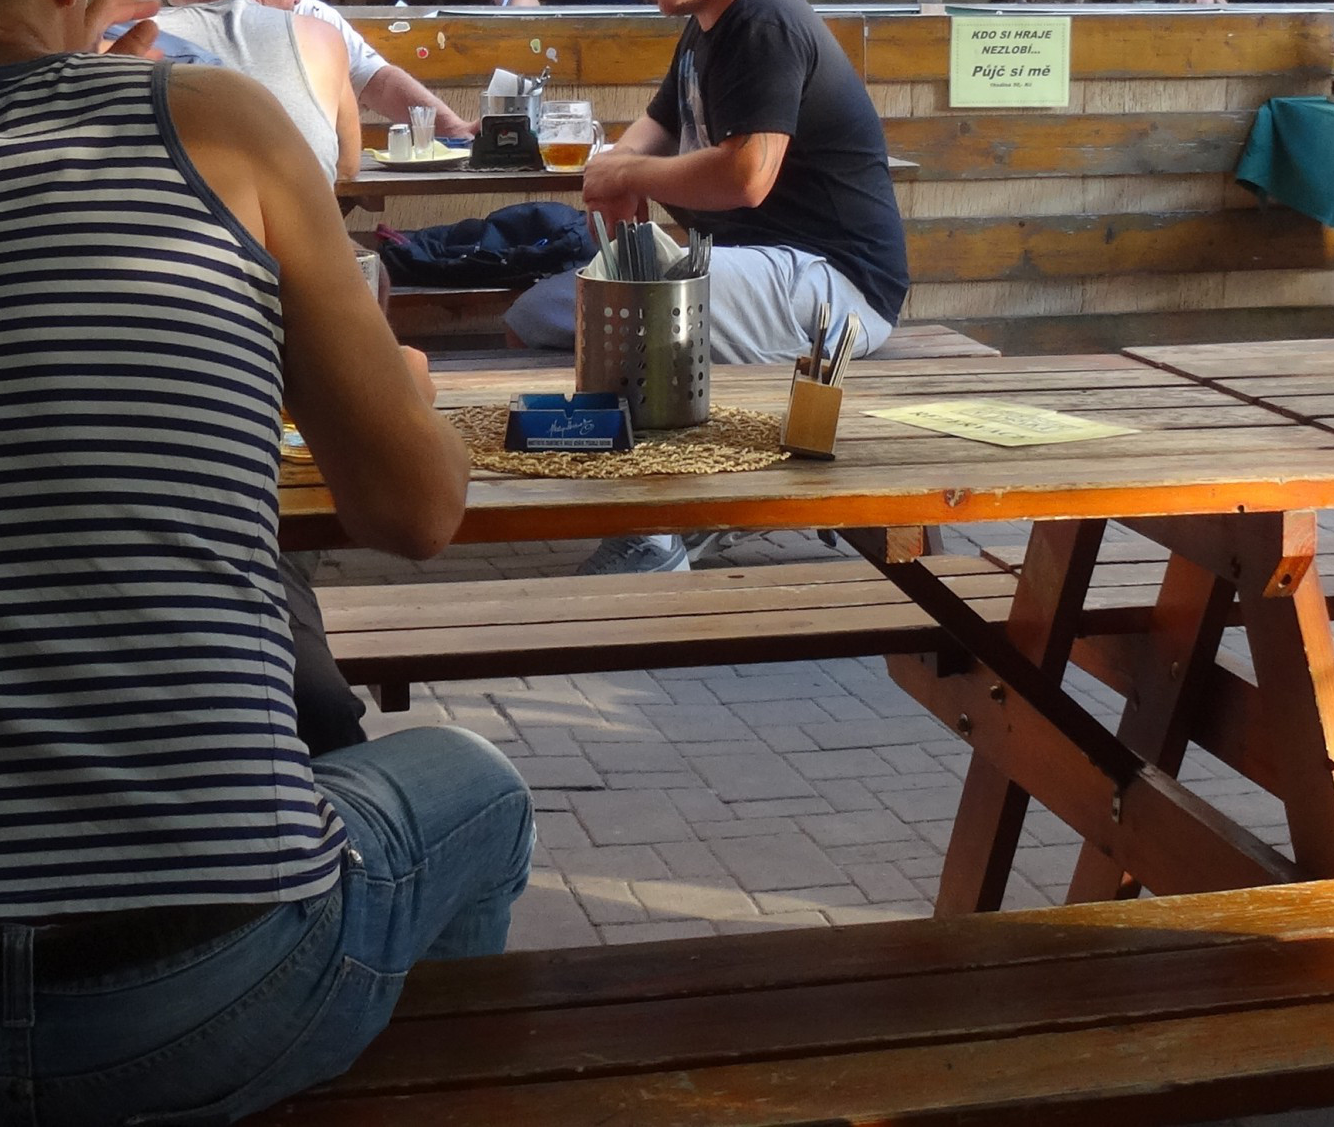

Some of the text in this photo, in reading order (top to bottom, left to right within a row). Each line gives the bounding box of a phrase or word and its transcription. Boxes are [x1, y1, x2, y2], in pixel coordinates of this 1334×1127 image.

[971, 30, 1053, 40] KDO SI HRAJE
[1009, 65, 1025, 77] si
[1027, 65, 1051, 77] mě
